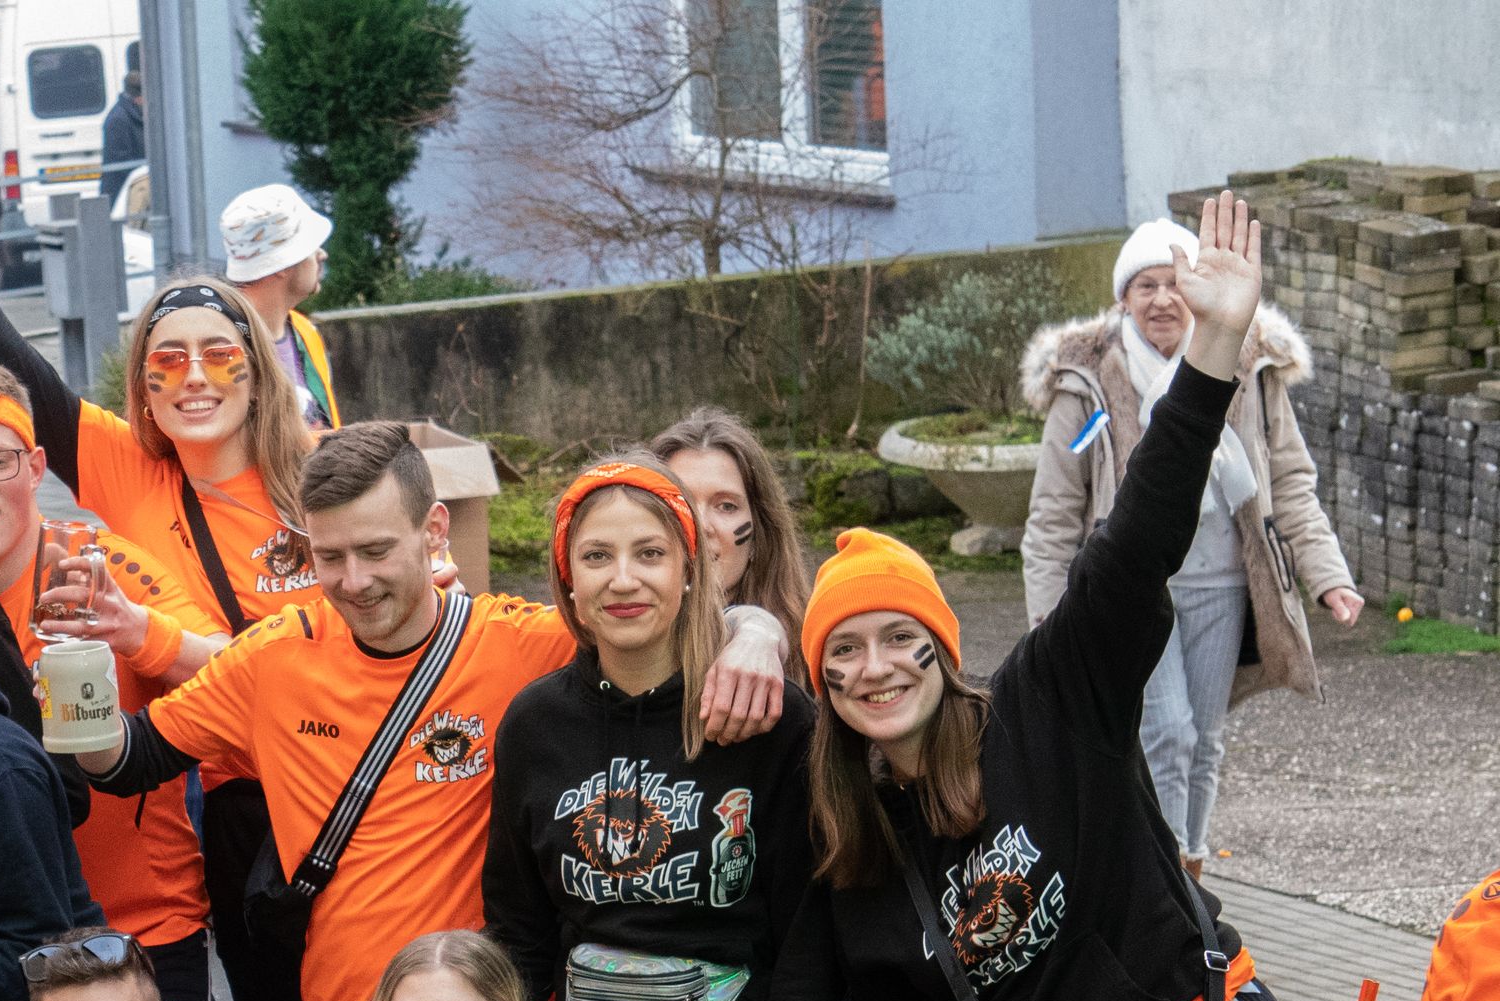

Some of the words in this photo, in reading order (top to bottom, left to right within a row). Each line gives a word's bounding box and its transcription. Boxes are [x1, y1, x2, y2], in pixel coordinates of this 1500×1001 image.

[60, 703, 114, 721] Bitburger
[297, 719, 340, 738] JAKO
[415, 746, 488, 783] KERLE
[561, 851, 700, 905] KERLE
[726, 868, 743, 882] FETT
